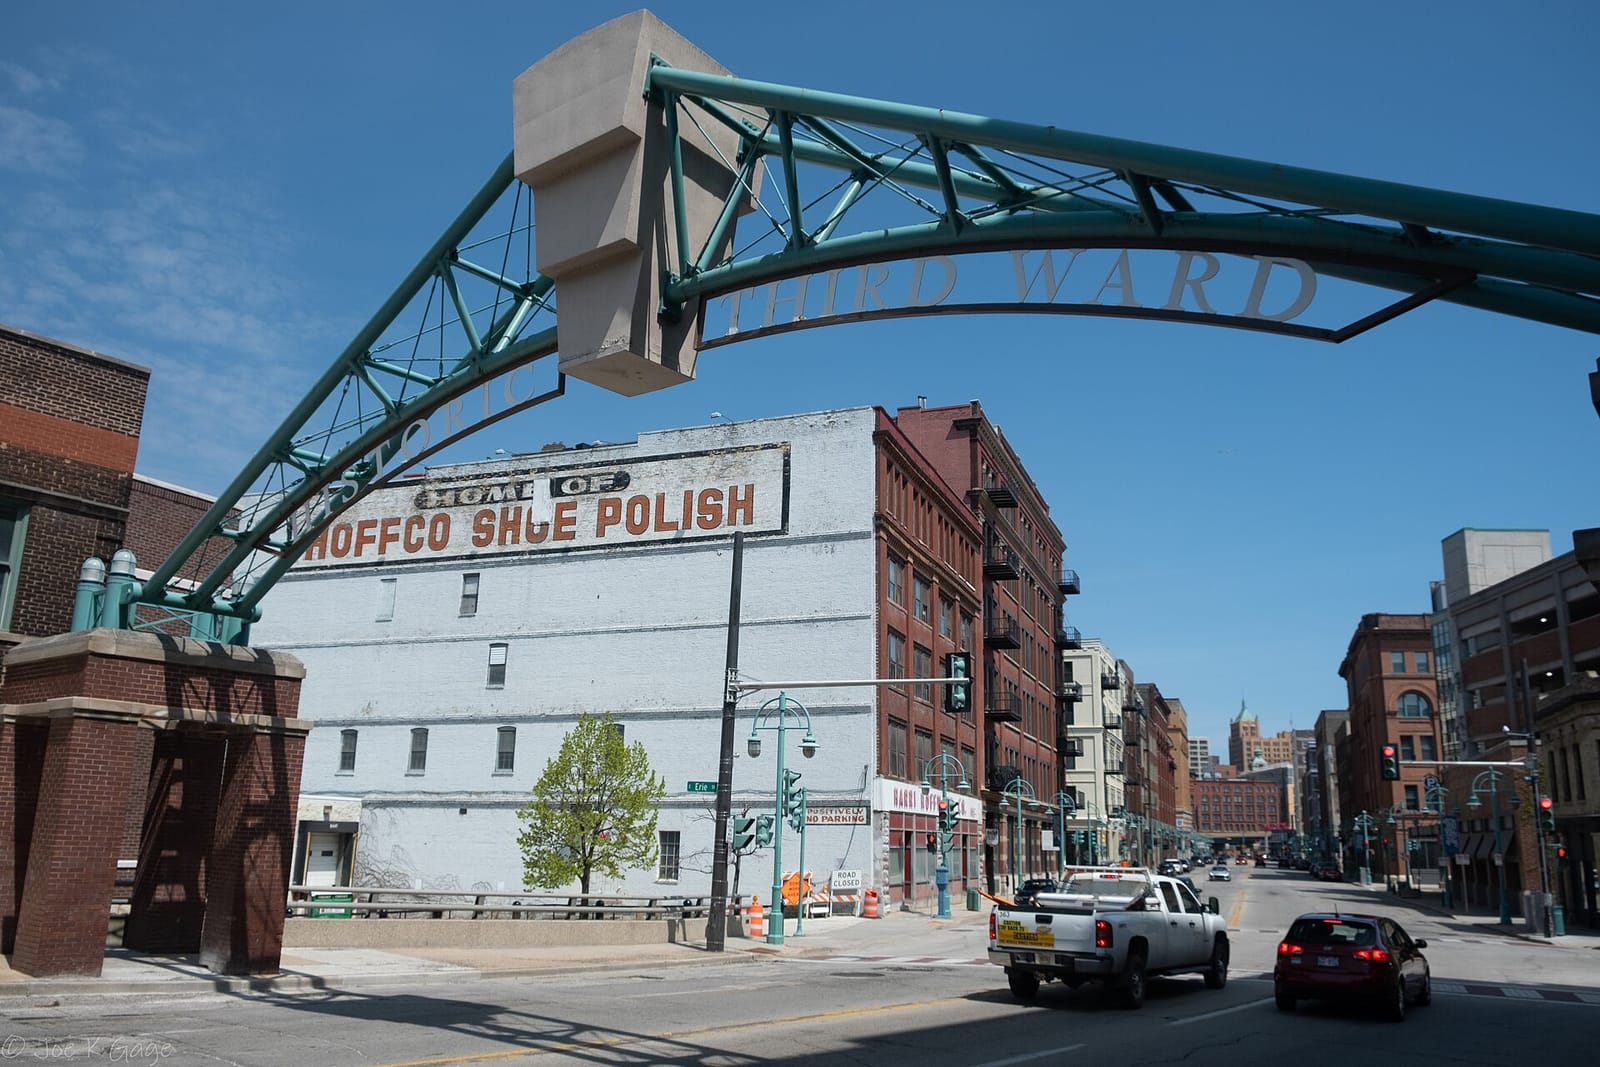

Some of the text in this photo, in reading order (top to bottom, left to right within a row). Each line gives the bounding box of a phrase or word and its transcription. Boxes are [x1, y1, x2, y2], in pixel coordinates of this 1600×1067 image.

[719, 255, 958, 336] THIRD
[1007, 247, 1318, 323] WARD
[560, 474, 617, 496] OF
[471, 500, 578, 548] SHOE
[595, 483, 756, 538] POLISH
[694, 782, 709, 792] Erie
[807, 807, 864, 815] POSITIVELY
[806, 815, 865, 823] NO PARKING
[837, 871, 857, 879] ROAD
[833, 879, 860, 887] CLOSED
